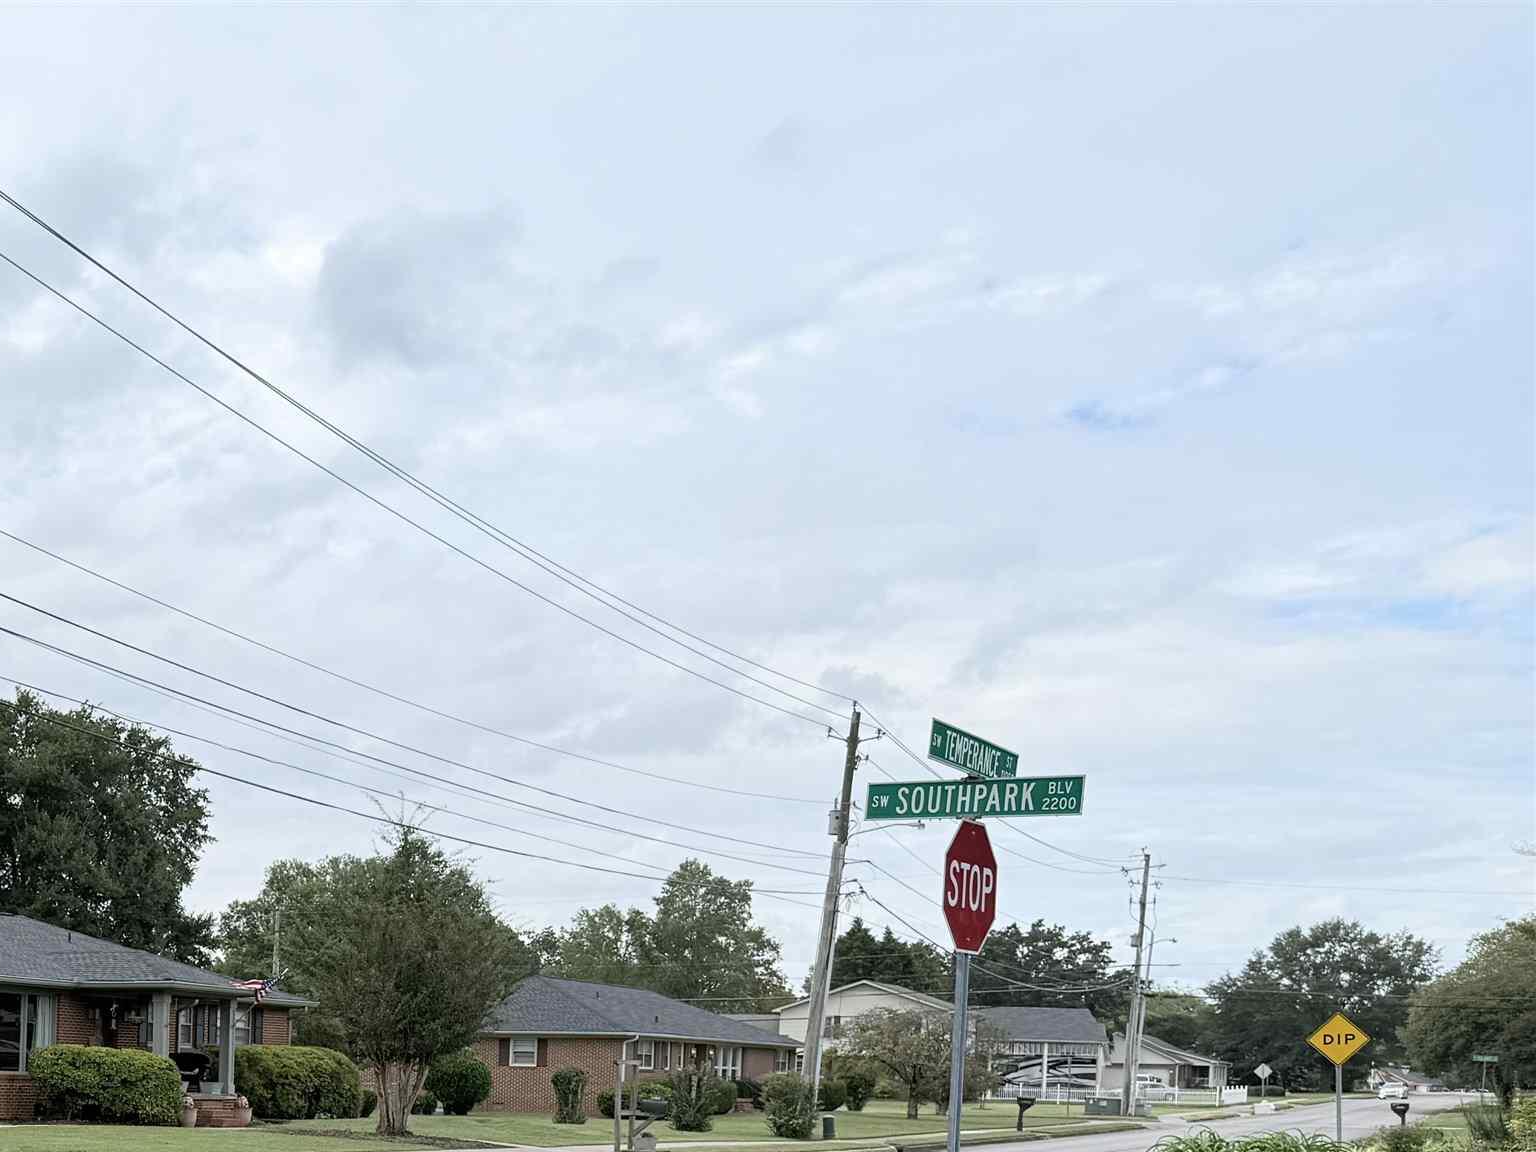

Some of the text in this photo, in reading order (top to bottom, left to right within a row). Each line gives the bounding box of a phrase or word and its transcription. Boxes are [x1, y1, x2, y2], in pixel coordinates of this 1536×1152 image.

[932, 733, 942, 748] SW
[944, 730, 1001, 778] TEMPERANCE
[1006, 756, 1013, 769] ST
[871, 782, 1037, 815] SW SOUTHPARK
[1048, 781, 1074, 795] BLV
[1041, 797, 1077, 811] 2200
[947, 859, 994, 913] STOP
[1323, 1033, 1356, 1046] DIP
